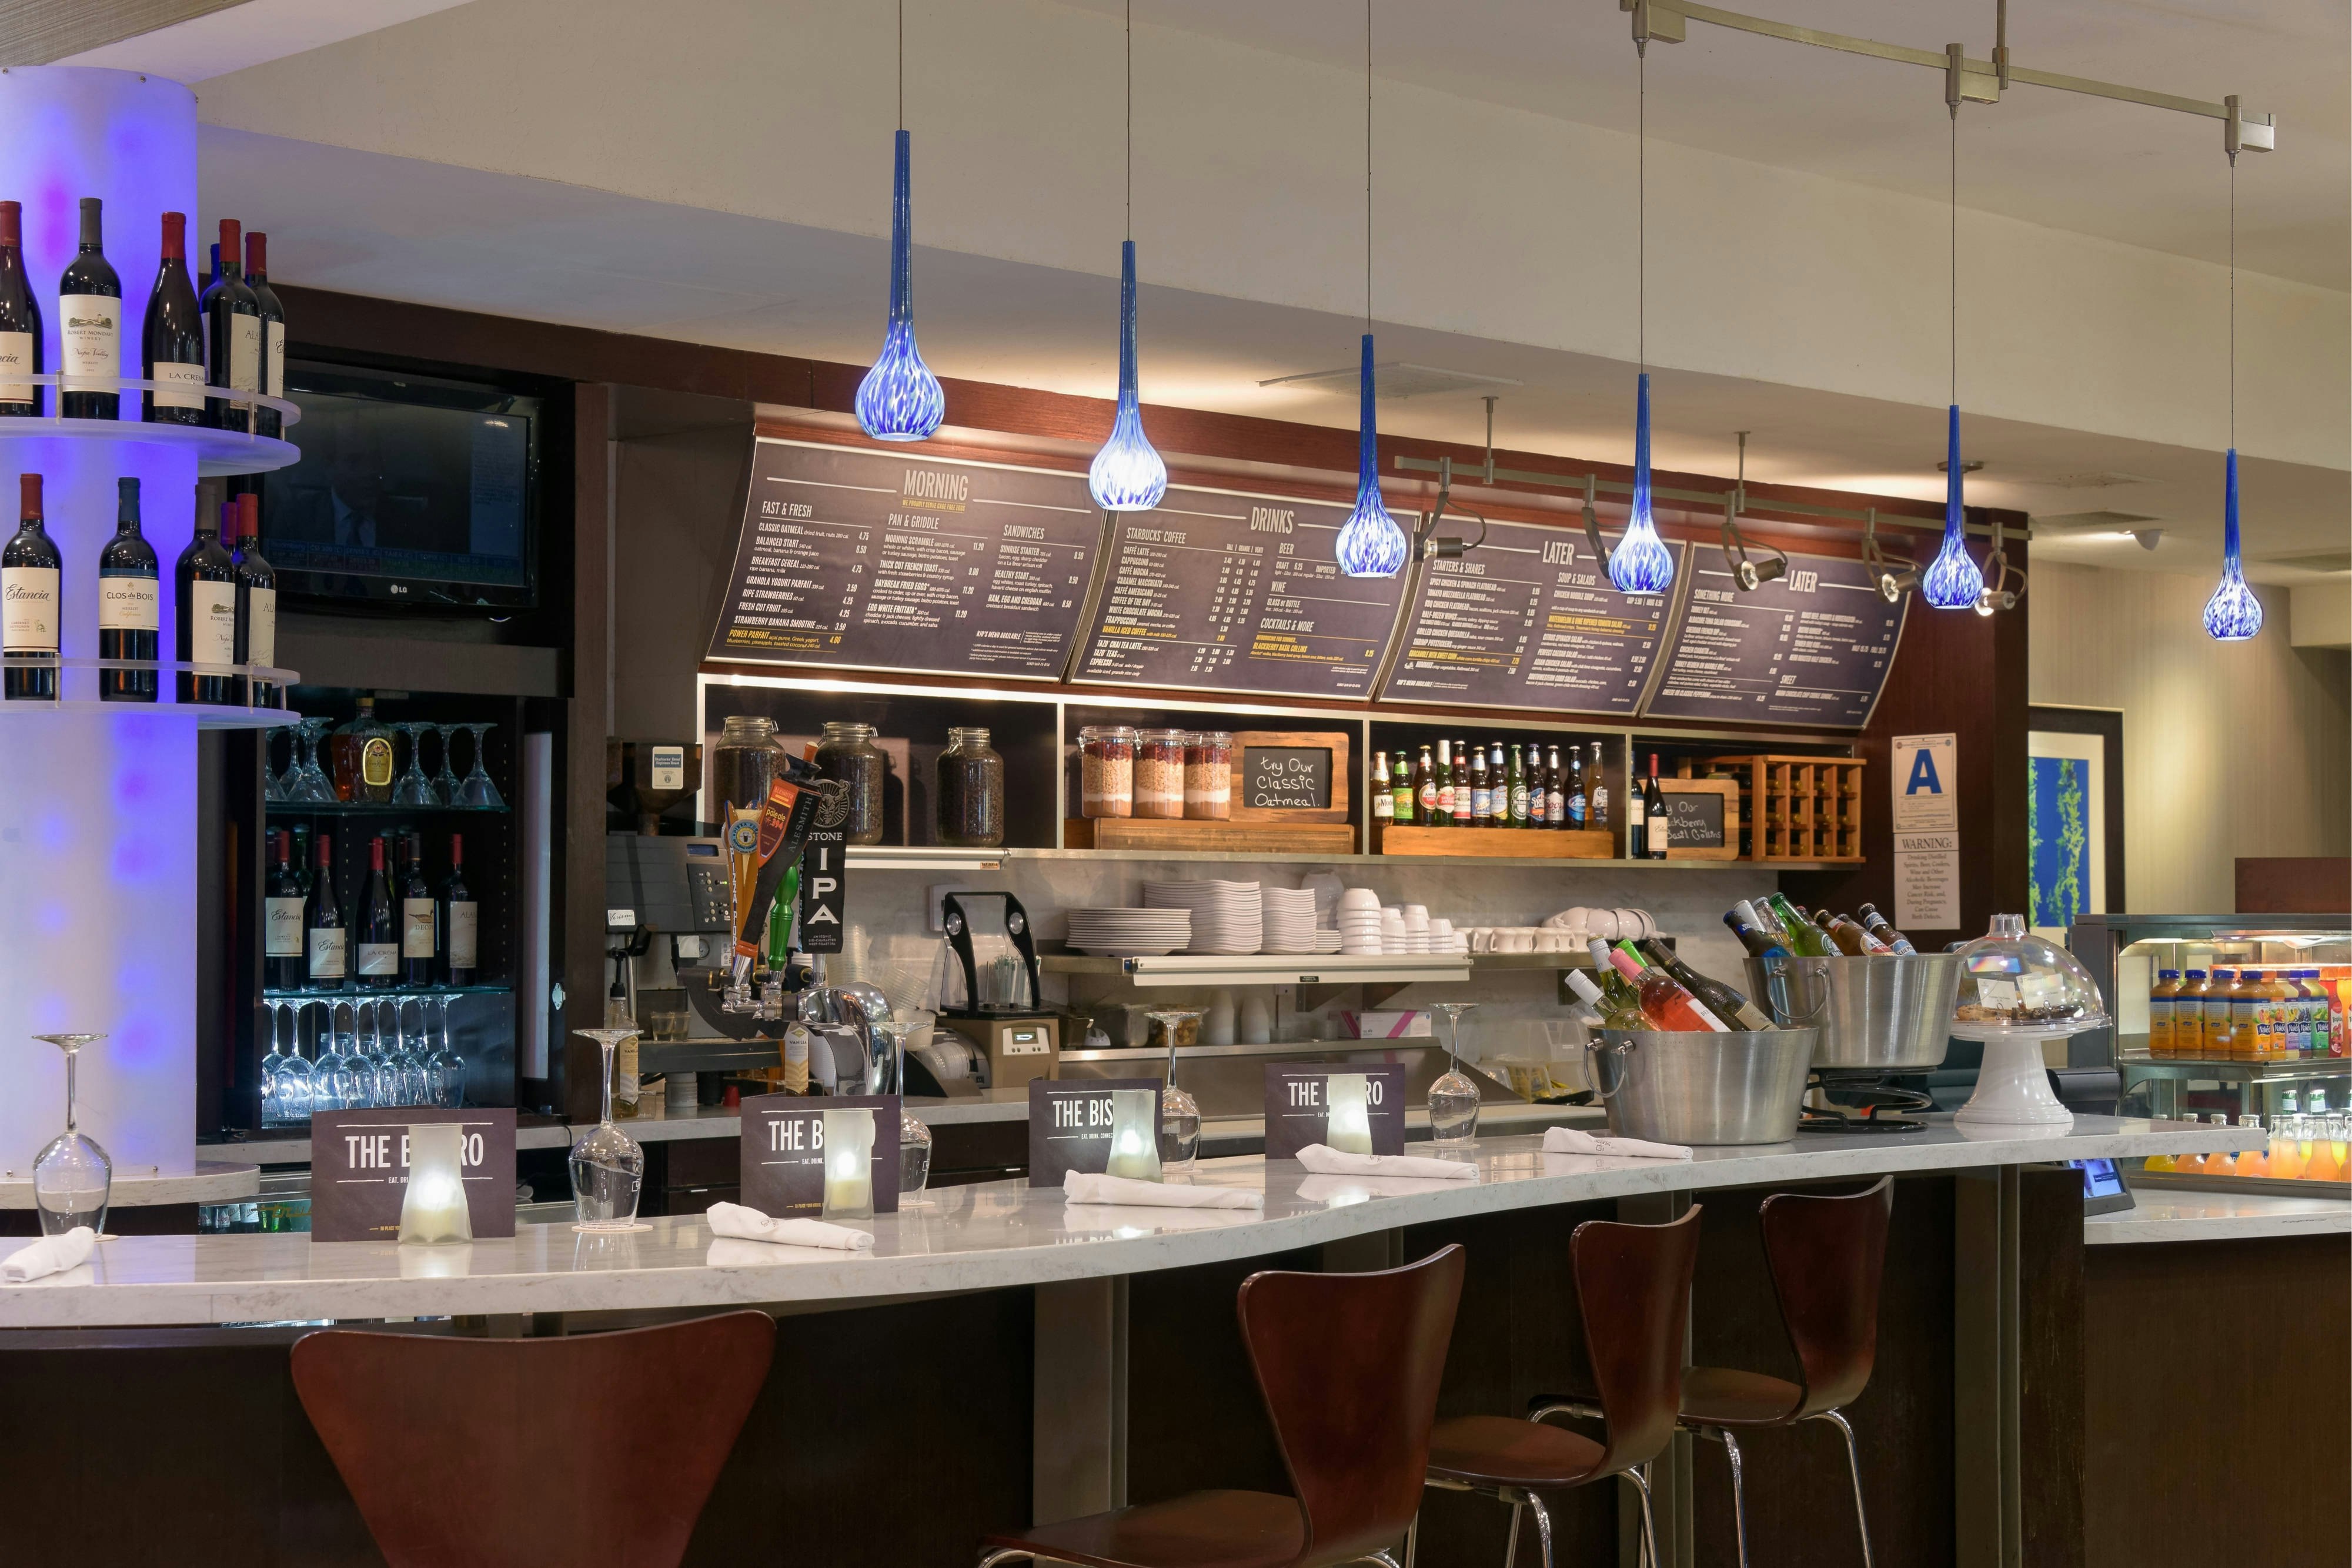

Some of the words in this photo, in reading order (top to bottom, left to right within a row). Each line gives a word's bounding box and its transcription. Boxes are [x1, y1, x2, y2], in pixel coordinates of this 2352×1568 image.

[71, 347, 90, 359] Napa
[91, 348, 109, 360] Valley
[904, 469, 968, 501] MORNING
[762, 501, 780, 514] FAST
[781, 503, 787, 514] &
[789, 504, 812, 517] FRESH
[888, 513, 902, 526] PAN
[904, 515, 909, 527] &
[911, 516, 940, 530] GRIDDLE
[1251, 506, 1294, 534] DRINKS
[759, 523, 780, 532] CLASSIC
[781, 524, 803, 534] OATMEAL
[1004, 524, 1044, 540] SANDWICHES
[756, 536, 783, 546] BALANCED
[783, 539, 799, 548] START
[858, 532, 869, 540] 4.75
[885, 534, 908, 544] MORNING
[908, 536, 934, 547] SCRAMBLE
[1164, 532, 1187, 544] COFFEE
[856, 546, 867, 554] 6.50
[973, 543, 984, 551] 11.20
[1000, 545, 1020, 554] SUNRISE
[1020, 546, 1040, 556] STARTER
[1137, 548, 1150, 556] LATTE
[1279, 543, 1294, 555] BEER
[1542, 541, 1575, 566] LATER
[1074, 551, 1084, 560] 8.50
[1121, 556, 1149, 566] CAPPUCCINO
[751, 557, 780, 566] BREAKFAST
[781, 559, 799, 569] CEREAL
[880, 560, 894, 569] THICK
[904, 563, 923, 571] FRENCH
[923, 564, 938, 573] TOAST
[1276, 561, 1289, 570] CRAFT
[1315, 565, 1336, 574] IMPORTED
[1433, 560, 1459, 573] STARTERS
[1459, 563, 1464, 573] &
[1465, 563, 1485, 575] SHARES
[968, 568, 979, 576] 9.00
[746, 576, 770, 586] GRANOLA
[771, 578, 791, 587] YOGURT
[791, 580, 812, 589] PARFAIT
[1558, 572, 1571, 583] SOUP
[1572, 574, 1576, 584] &
[1576, 574, 1596, 586] SALADS
[1789, 570, 1818, 593] LATER
[6, 583, 51, 602] Estancia
[1271, 581, 1287, 593] WINE
[106, 591, 126, 600] CLOS
[136, 592, 153, 601] BOIS
[1111, 596, 1127, 605] COFFEE
[734, 616, 768, 626] STRAWBERRY
[769, 618, 789, 627] BANANA
[790, 620, 816, 629] SMOOTHIE
[1105, 616, 1137, 626] FRAPPUCCINO
[1261, 618, 1291, 631] COCKTAILS
[1291, 620, 1295, 631] &
[1297, 621, 1315, 633] MORE
[729, 629, 748, 638] POWER
[748, 631, 770, 639] PARFAIT
[1102, 625, 1120, 633] VANILLA
[1131, 627, 1147, 636] COFFEE
[1090, 658, 1112, 667] ESPRESSO
[1289, 758, 1314, 773] Our
[1906, 748, 1943, 795] A
[1257, 775, 1315, 790] Classic
[1255, 793, 1319, 807] Oatmeal.
[1679, 801, 1698, 813] Our
[766, 808, 779, 818] pale
[777, 813, 786, 822] ale
[788, 797, 813, 853] ALESMITH
[808, 832, 843, 841] STONE
[1667, 830, 1689, 840] Basil
[1692, 829, 1722, 840] Collins
[1902, 837, 1952, 850] WARNING:
[807, 847, 840, 924] IPA
[271, 909, 301, 921] Estancia
[1288, 1082, 1319, 1106] THE
[1053, 1100, 1083, 1128] THE
[1090, 1098, 1113, 1126] BIS
[768, 1120, 804, 1151] THE
[345, 1135, 391, 1169] THE
[401, 1132, 483, 1168] BRO
